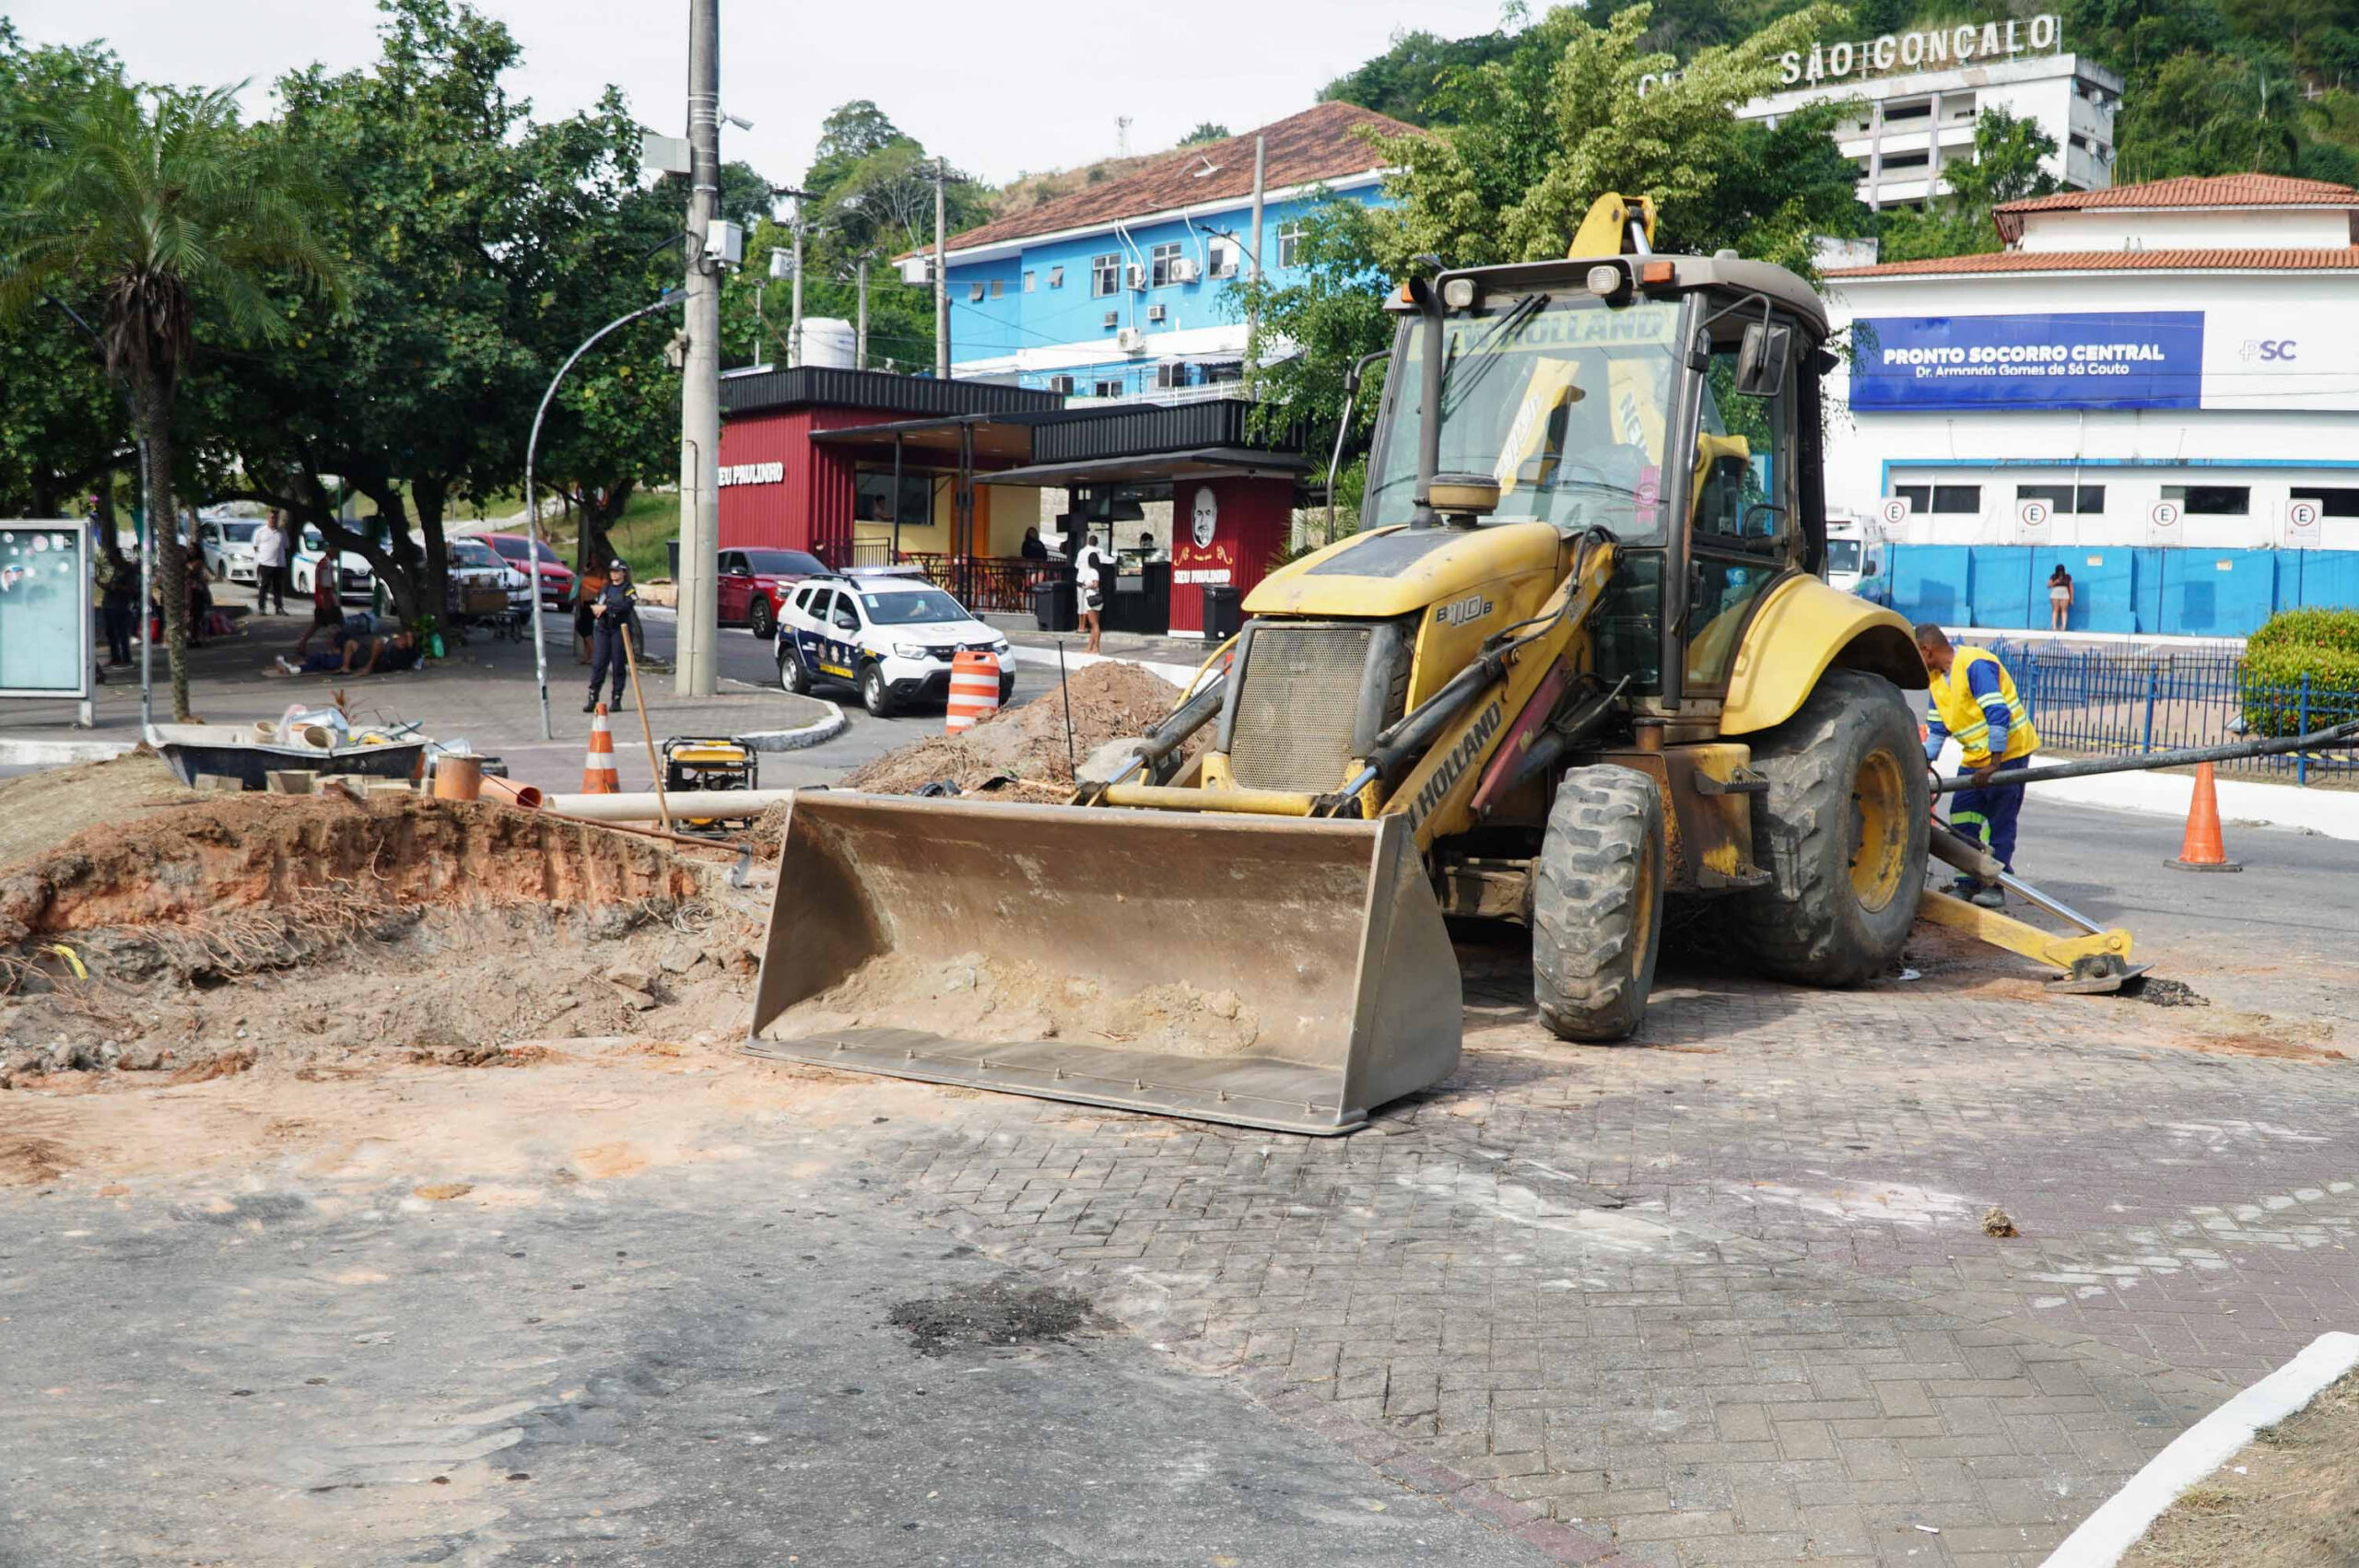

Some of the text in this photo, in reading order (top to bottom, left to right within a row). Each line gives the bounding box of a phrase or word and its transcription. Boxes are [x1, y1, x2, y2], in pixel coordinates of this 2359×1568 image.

[1780, 41, 1852, 84] SÃO
[1884, 344, 2165, 365] PRONTO SOCORRO CENTRAL
[1916, 360, 2130, 379] Dr. Armando Gomes de Sá Couto
[1891, 506, 1899, 520] E
[2030, 508, 2038, 521] E
[2160, 509, 2169, 521] E
[2299, 509, 2307, 522] E
[1417, 700, 1502, 818] HOLLAND
